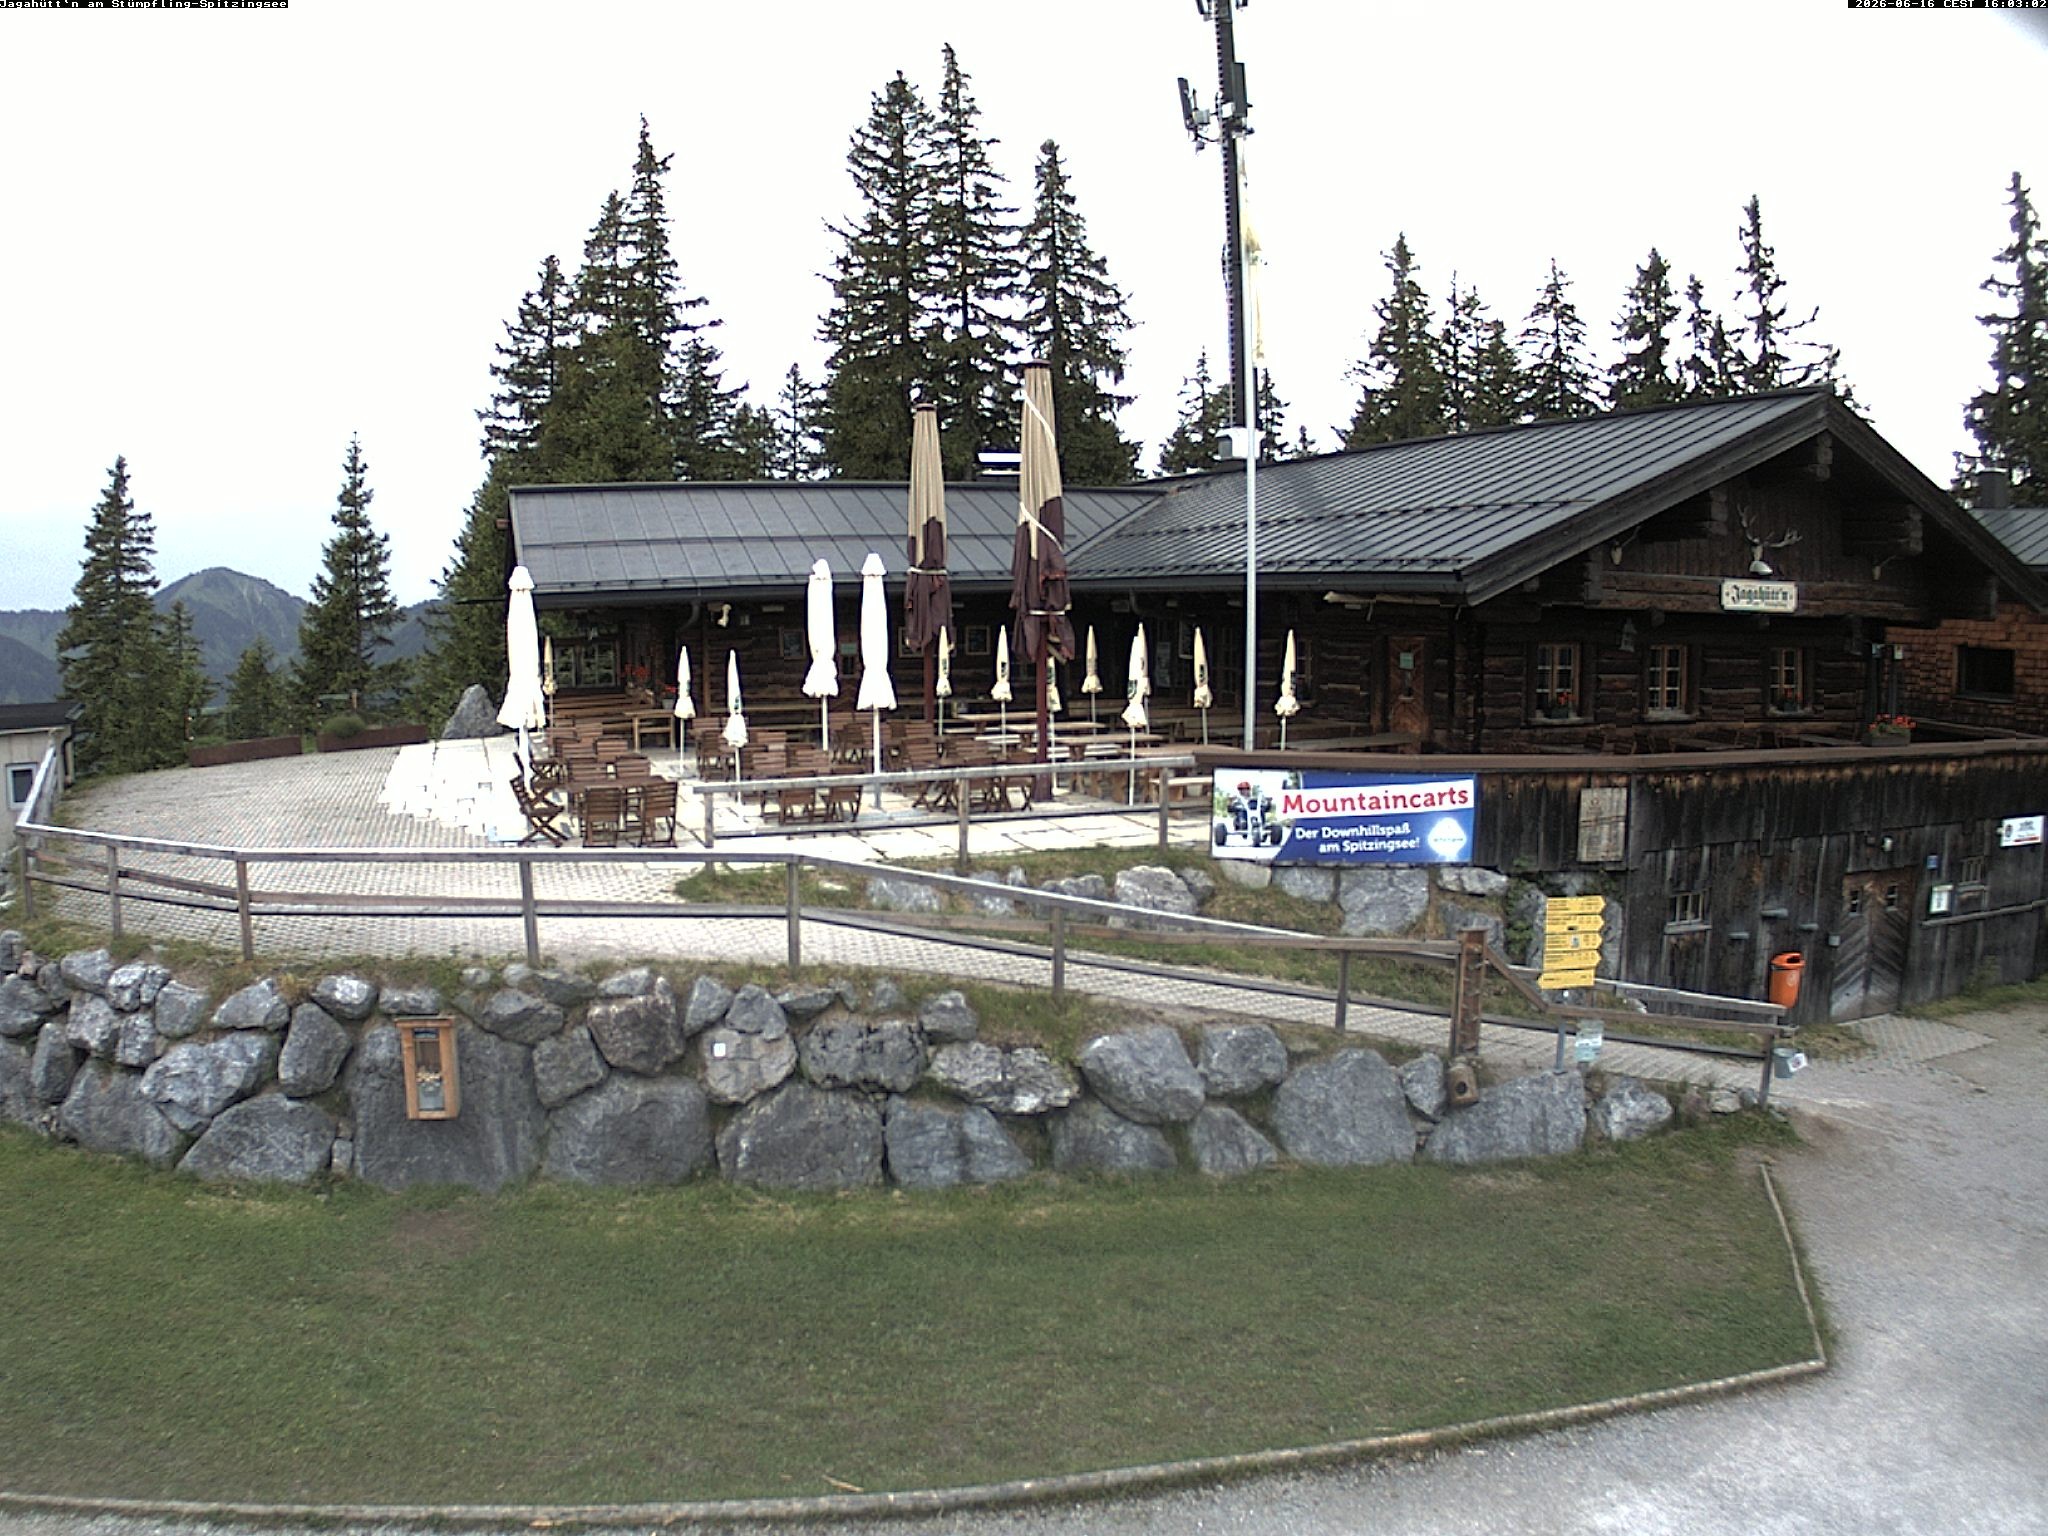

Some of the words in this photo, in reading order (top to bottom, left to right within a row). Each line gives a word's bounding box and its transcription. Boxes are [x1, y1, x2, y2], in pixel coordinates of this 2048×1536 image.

[1282, 786, 1469, 815] Mountaincarts
[1295, 827, 1319, 839] Der
[1322, 822, 1411, 839] Downhillspaß
[1319, 842, 1341, 854] am
[1344, 837, 1420, 853] Spitzingsee!
